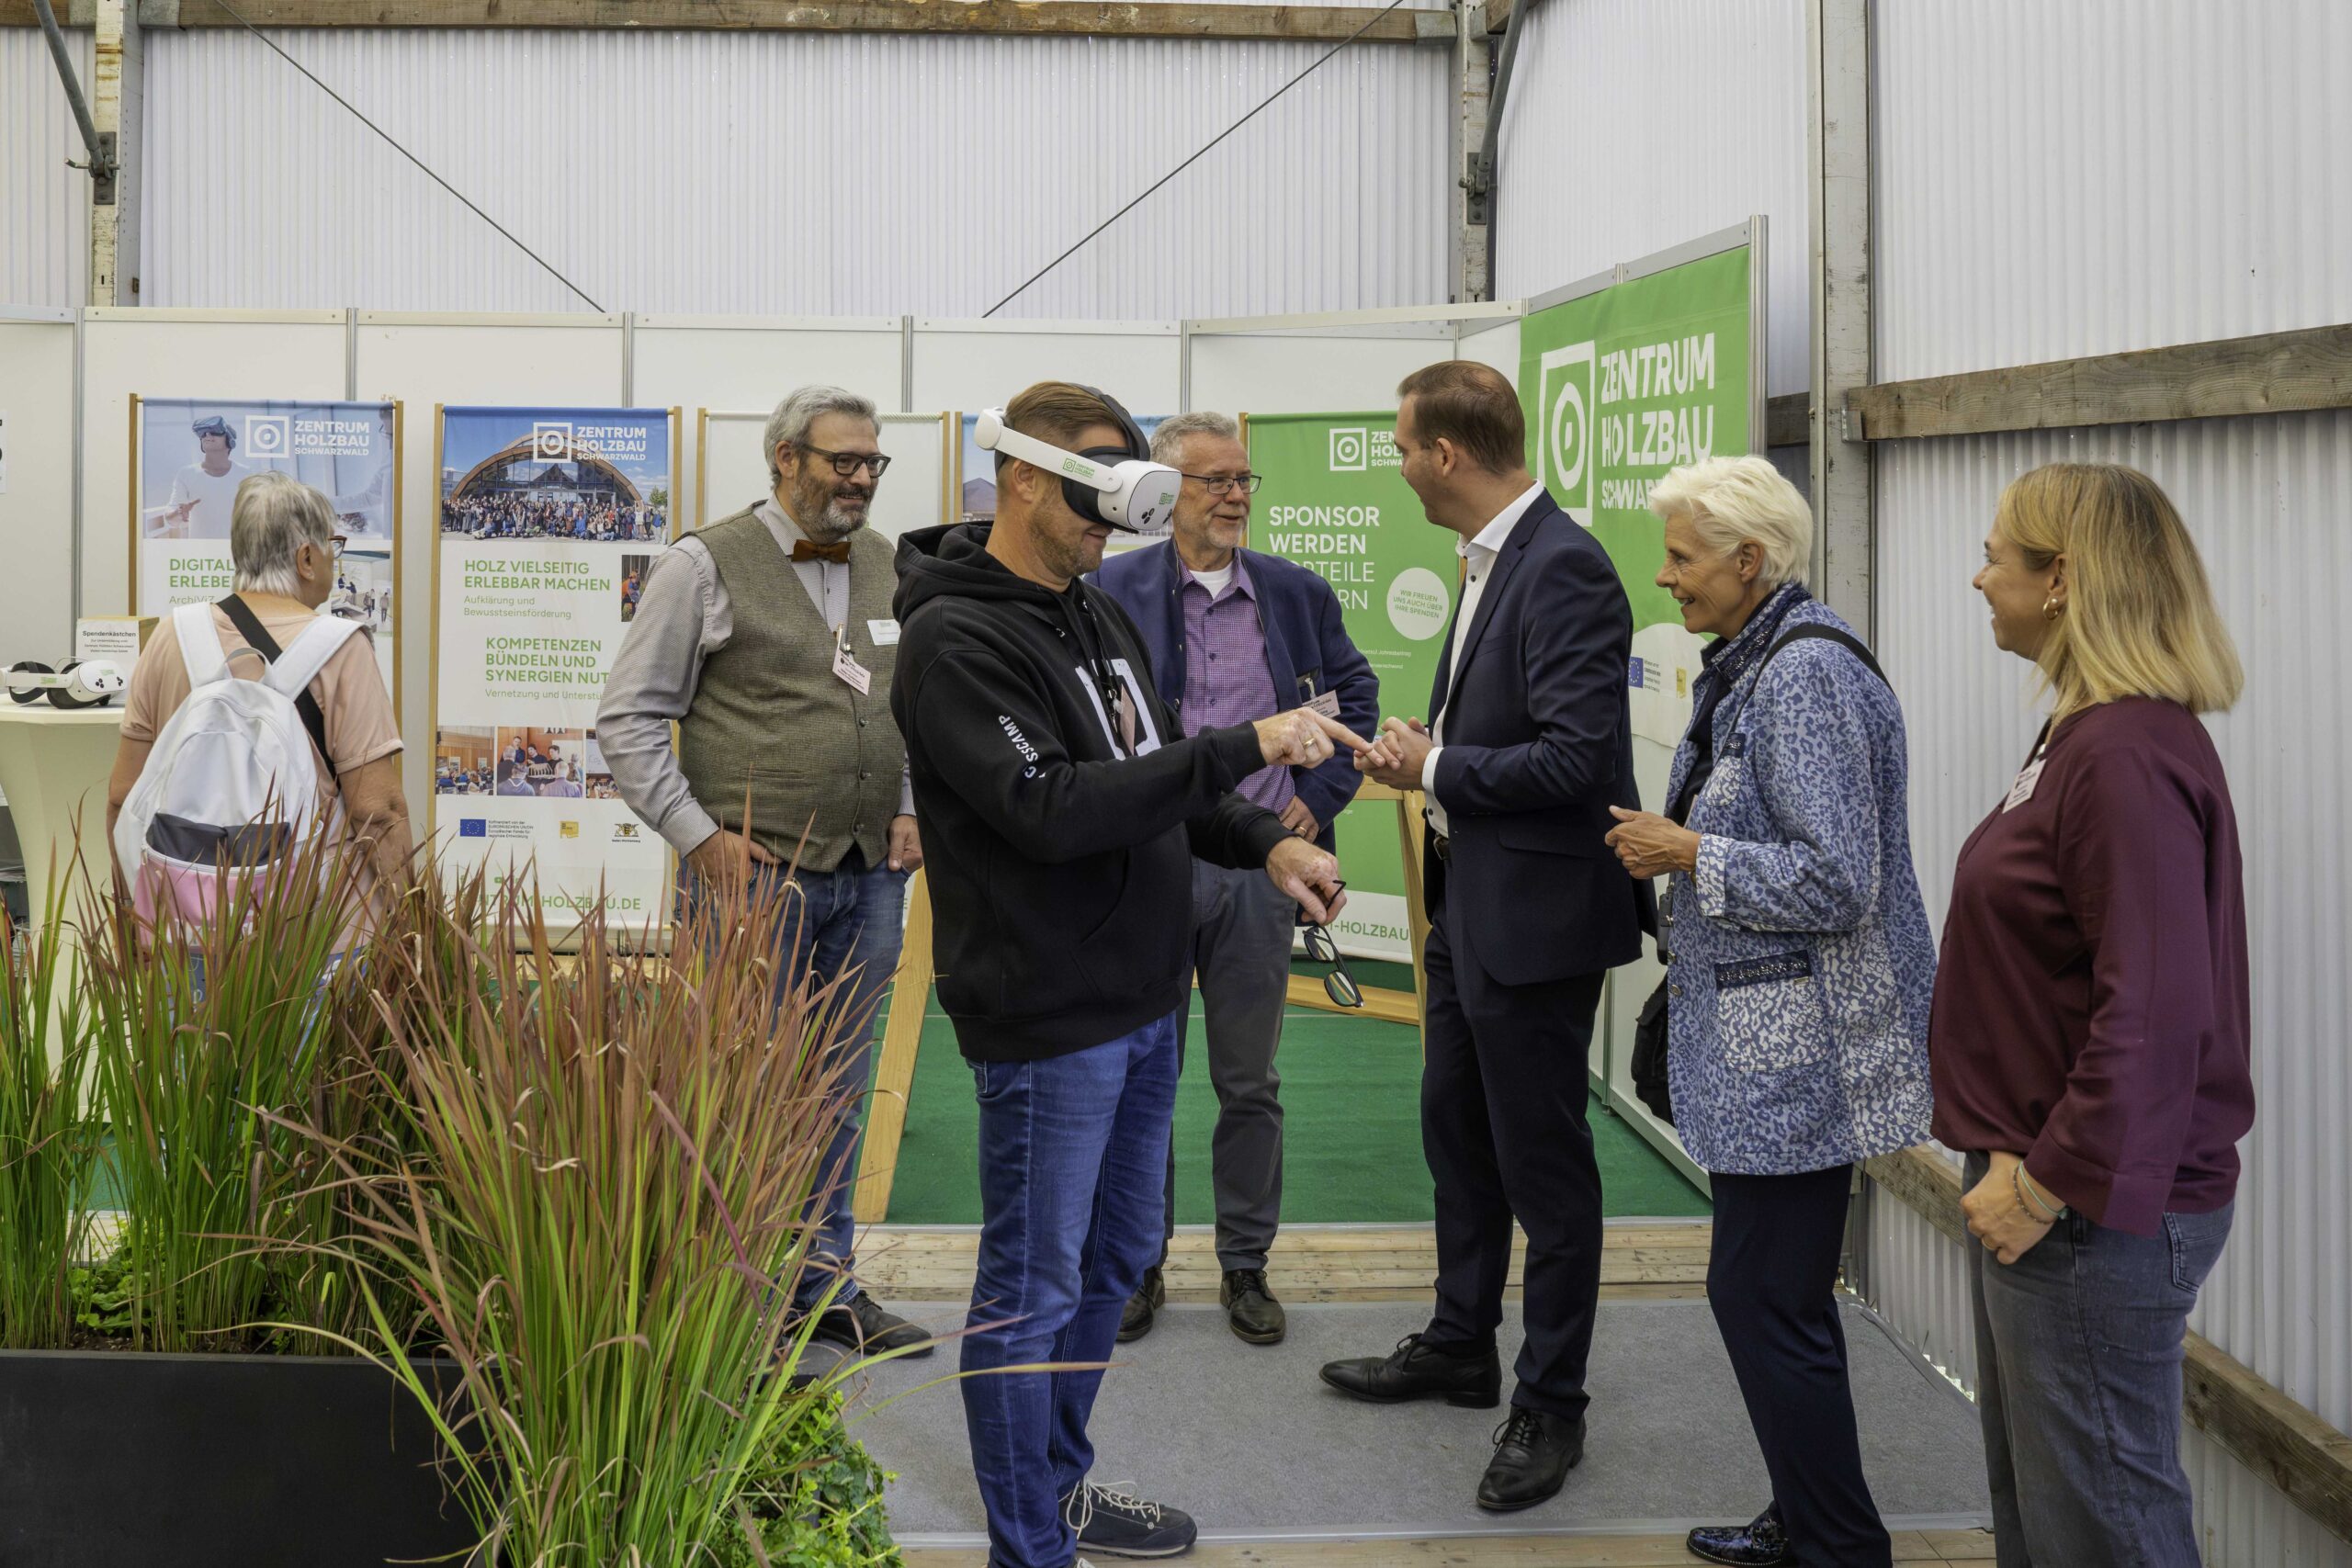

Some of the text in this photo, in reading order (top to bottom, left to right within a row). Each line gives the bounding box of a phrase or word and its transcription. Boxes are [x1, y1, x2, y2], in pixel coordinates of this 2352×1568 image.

[1600, 333, 1714, 404] ZENTRUM
[295, 420, 369, 434] ZENTRUM
[577, 426, 647, 438] ZENTRUM
[295, 434, 369, 446] HOLZBAU
[1601, 404, 1714, 468] HOLZBAU
[295, 447, 369, 456] SCHWARZWALD
[577, 439, 646, 452] HOLZBAU
[577, 452, 646, 461] SCHWARZWALD
[1601, 479, 1664, 510] SCHWA
[1269, 506, 1380, 527] SPONSOR
[1269, 533, 1366, 555] WERDEN
[170, 558, 235, 571] DIGITAL
[464, 559, 590, 574] HOLZ VIELSEITIG
[1291, 560, 1375, 582] TEILE
[464, 576, 610, 591] ERLEBBAR MACHEN
[464, 594, 536, 607] Aufklärung und
[464, 607, 571, 620] Bewusstseinsförderung
[486, 637, 602, 652] KOMPETENZEN
[486, 650, 596, 668] BÜNDELN UND
[485, 669, 610, 684] SYNERGIEN NUT
[485, 689, 540, 700] Vernetzung
[543, 691, 560, 699] und
